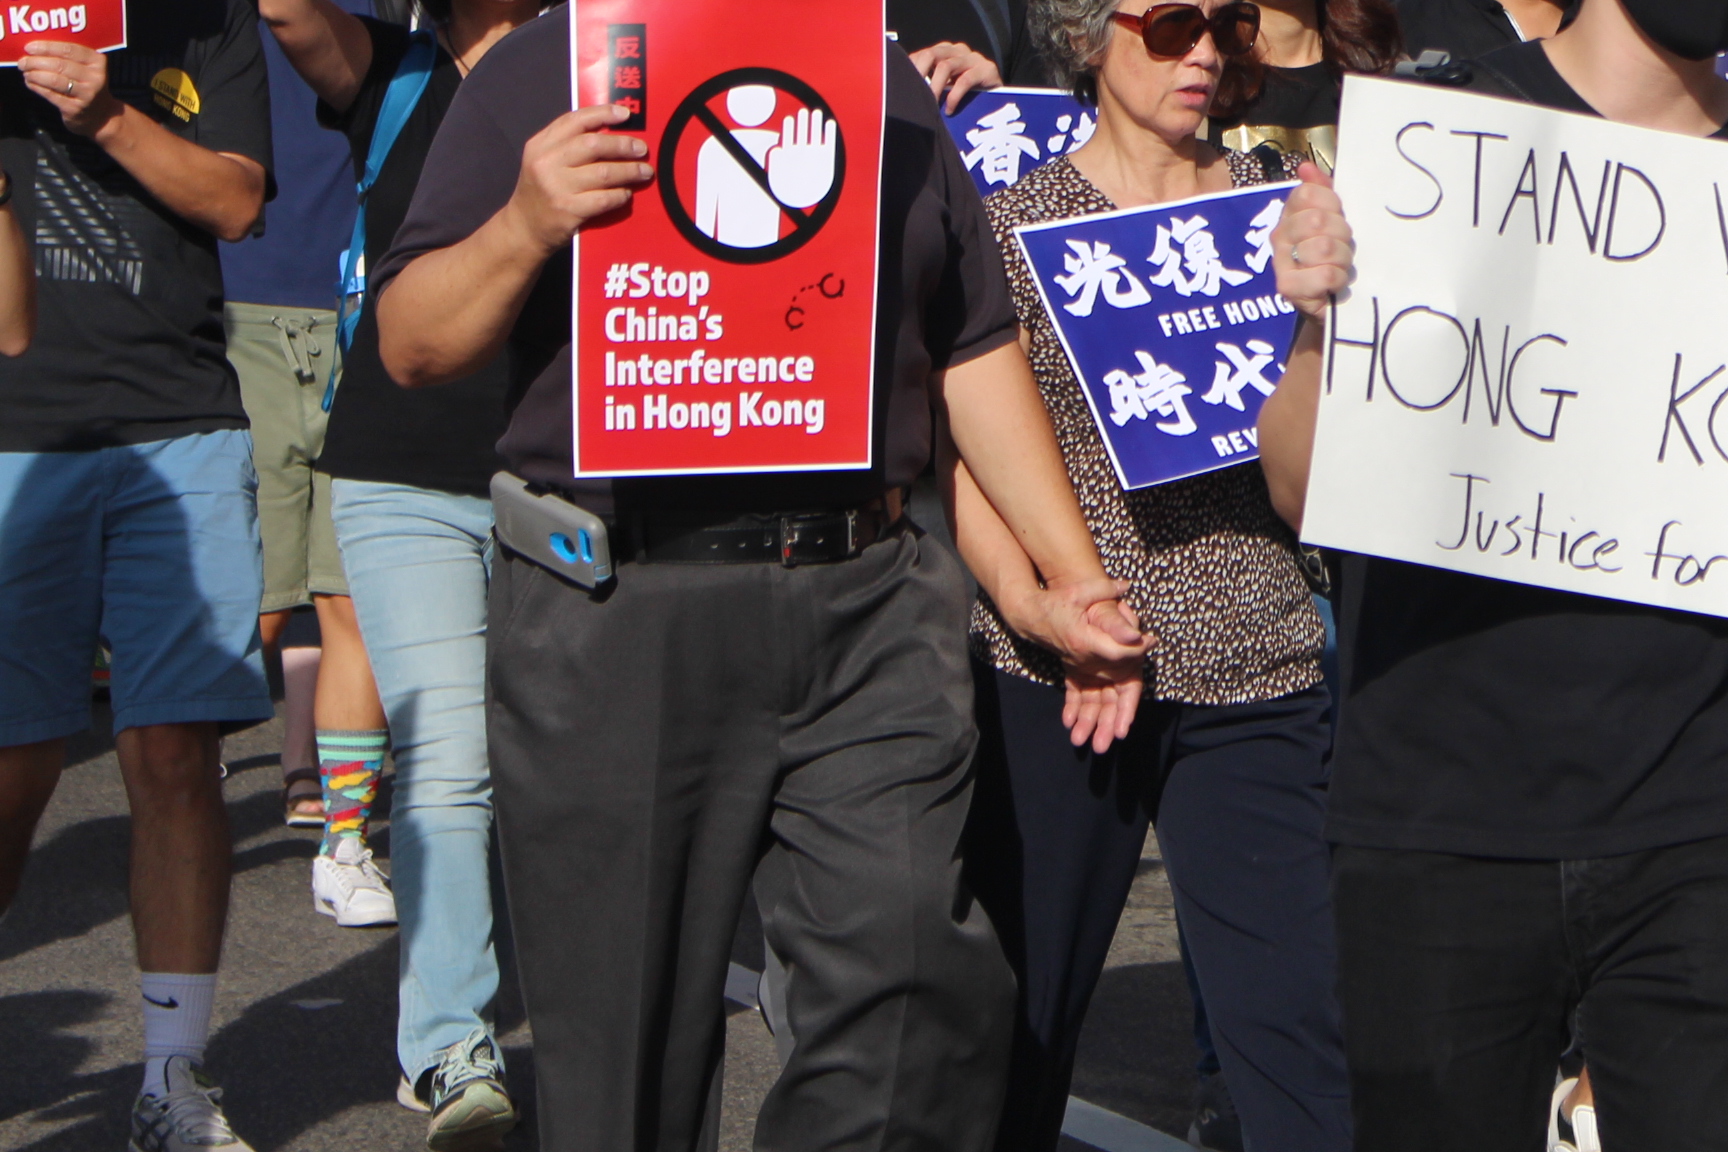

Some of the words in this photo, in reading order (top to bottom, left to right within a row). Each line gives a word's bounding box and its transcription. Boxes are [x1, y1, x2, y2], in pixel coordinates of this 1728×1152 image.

[8, 4, 87, 34] Kong
[180, 93, 196, 110] WITH
[1385, 121, 1667, 263] STAND
[604, 262, 710, 306] #Stop
[604, 305, 724, 343] China's
[1157, 306, 1222, 338] FREE
[1222, 293, 1297, 326] HONG
[605, 349, 815, 387] Interference
[1326, 293, 1578, 443] HONG
[605, 395, 636, 430] in
[643, 394, 732, 437] Hong
[738, 391, 825, 434] Kong
[1436, 471, 1624, 574] Justice
